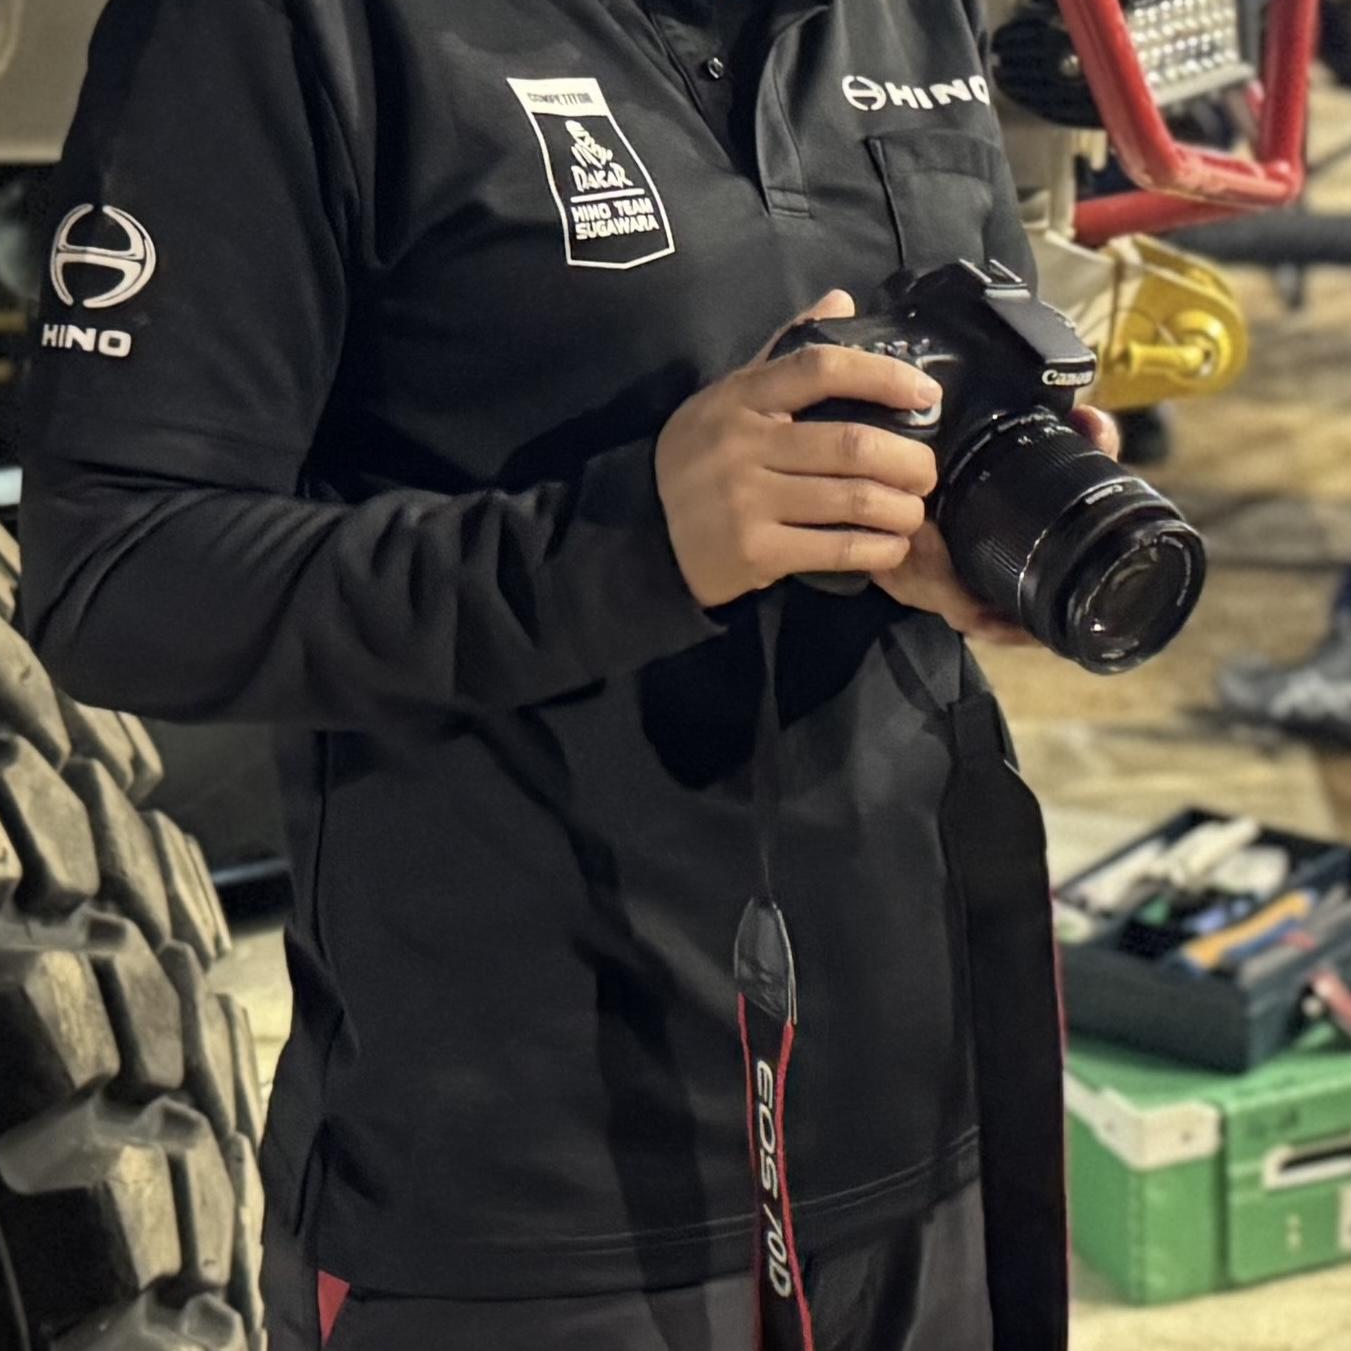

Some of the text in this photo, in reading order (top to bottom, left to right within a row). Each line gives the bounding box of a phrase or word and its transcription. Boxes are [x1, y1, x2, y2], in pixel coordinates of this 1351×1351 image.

[885, 74, 991, 110] HINO
[570, 162, 634, 192] DAKAR
[571, 197, 654, 222] HINO TEAM
[574, 215, 660, 240] SUGAWARA
[41, 323, 132, 358] HINO
[756, 1060, 777, 1200] EOS
